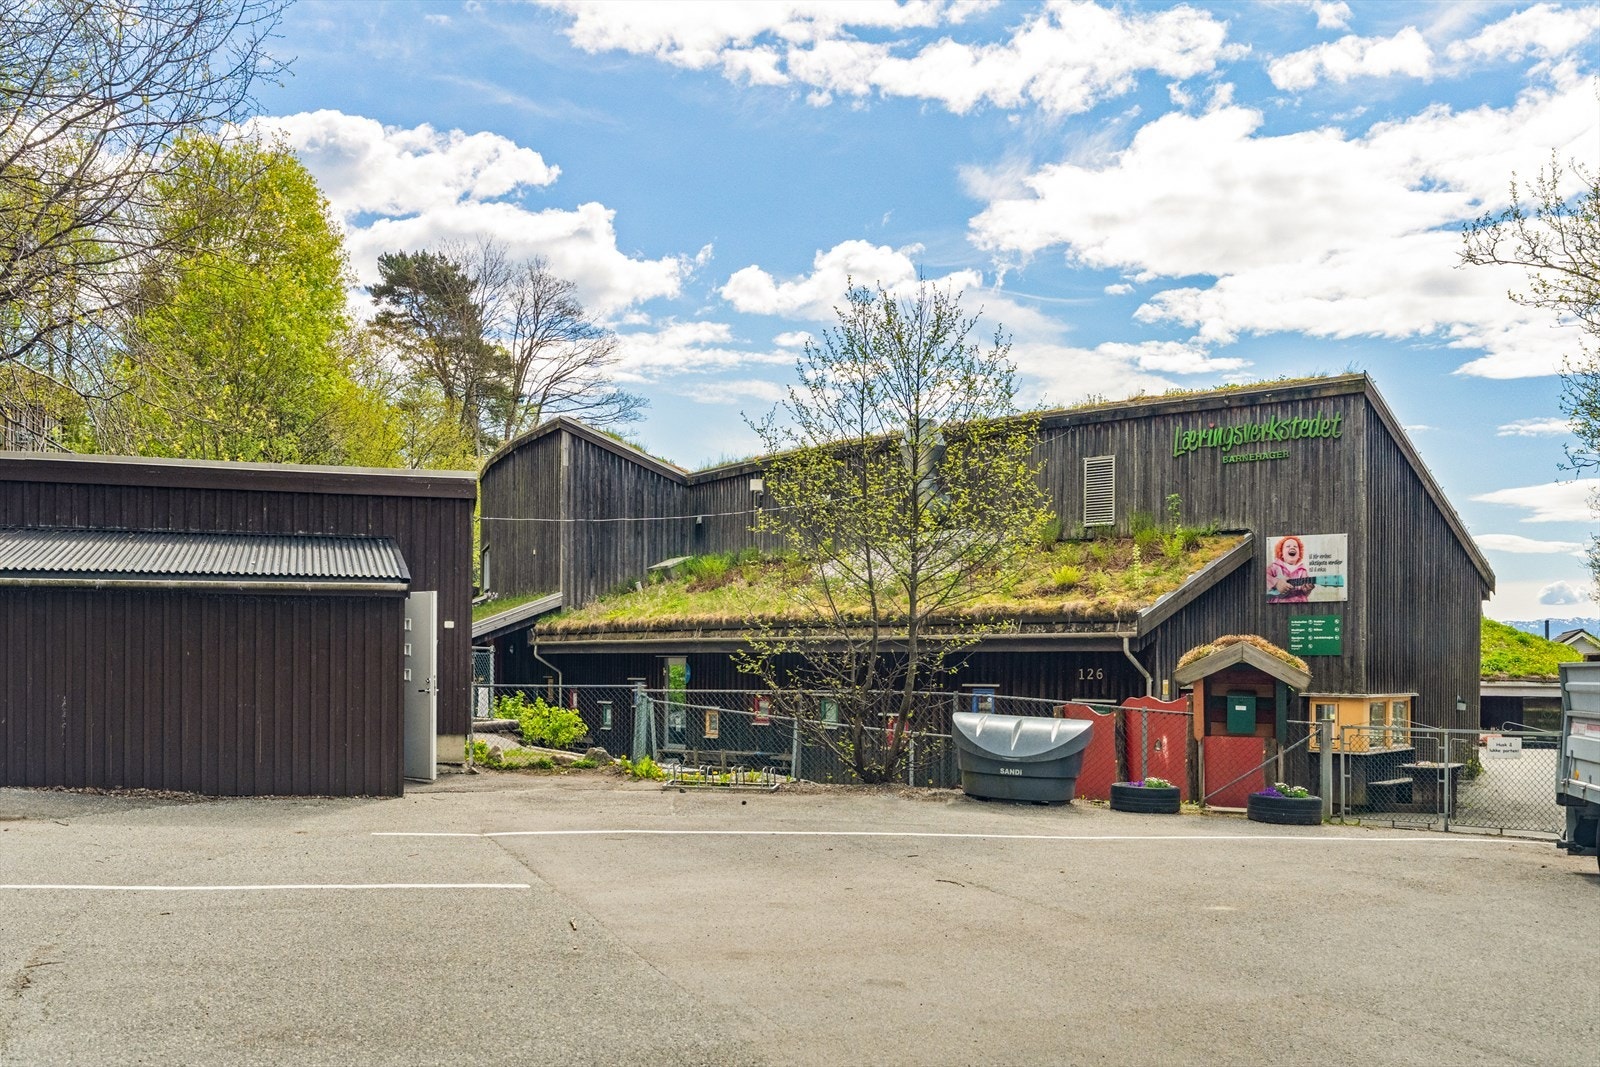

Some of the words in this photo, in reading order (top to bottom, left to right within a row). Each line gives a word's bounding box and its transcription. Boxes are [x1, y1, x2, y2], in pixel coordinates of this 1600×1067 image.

[1173, 410, 1343, 458] Læringsverkstedet
[1222, 451, 1291, 465] BARNEHAGER
[1079, 668, 1103, 680] 126
[1000, 768, 1023, 776] SANDI
